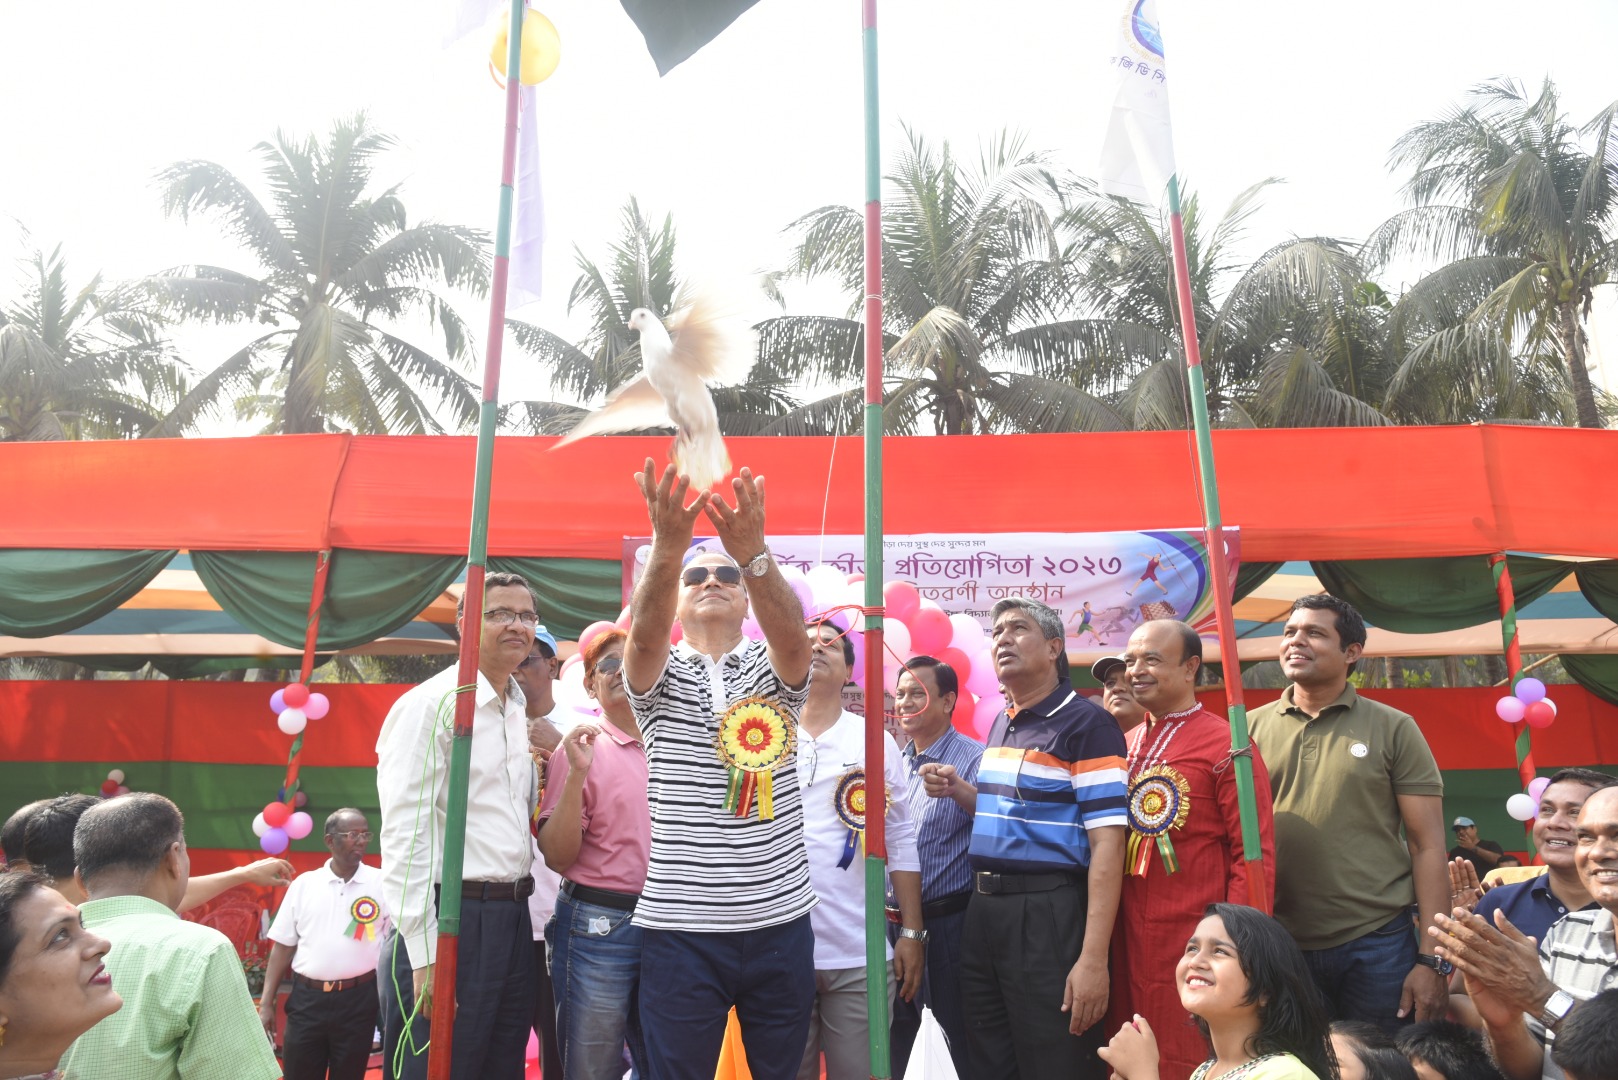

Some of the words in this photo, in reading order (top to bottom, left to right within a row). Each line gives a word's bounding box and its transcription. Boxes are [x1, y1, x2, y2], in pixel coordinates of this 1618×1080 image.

[883, 540, 896, 549] ড়া
[931, 540, 946, 548] দেহ
[895, 552, 1034, 579] প্রতিযোগিতা
[1042, 555, 1122, 576] ২০২৩
[987, 581, 1066, 602] অনষ্ঠান
